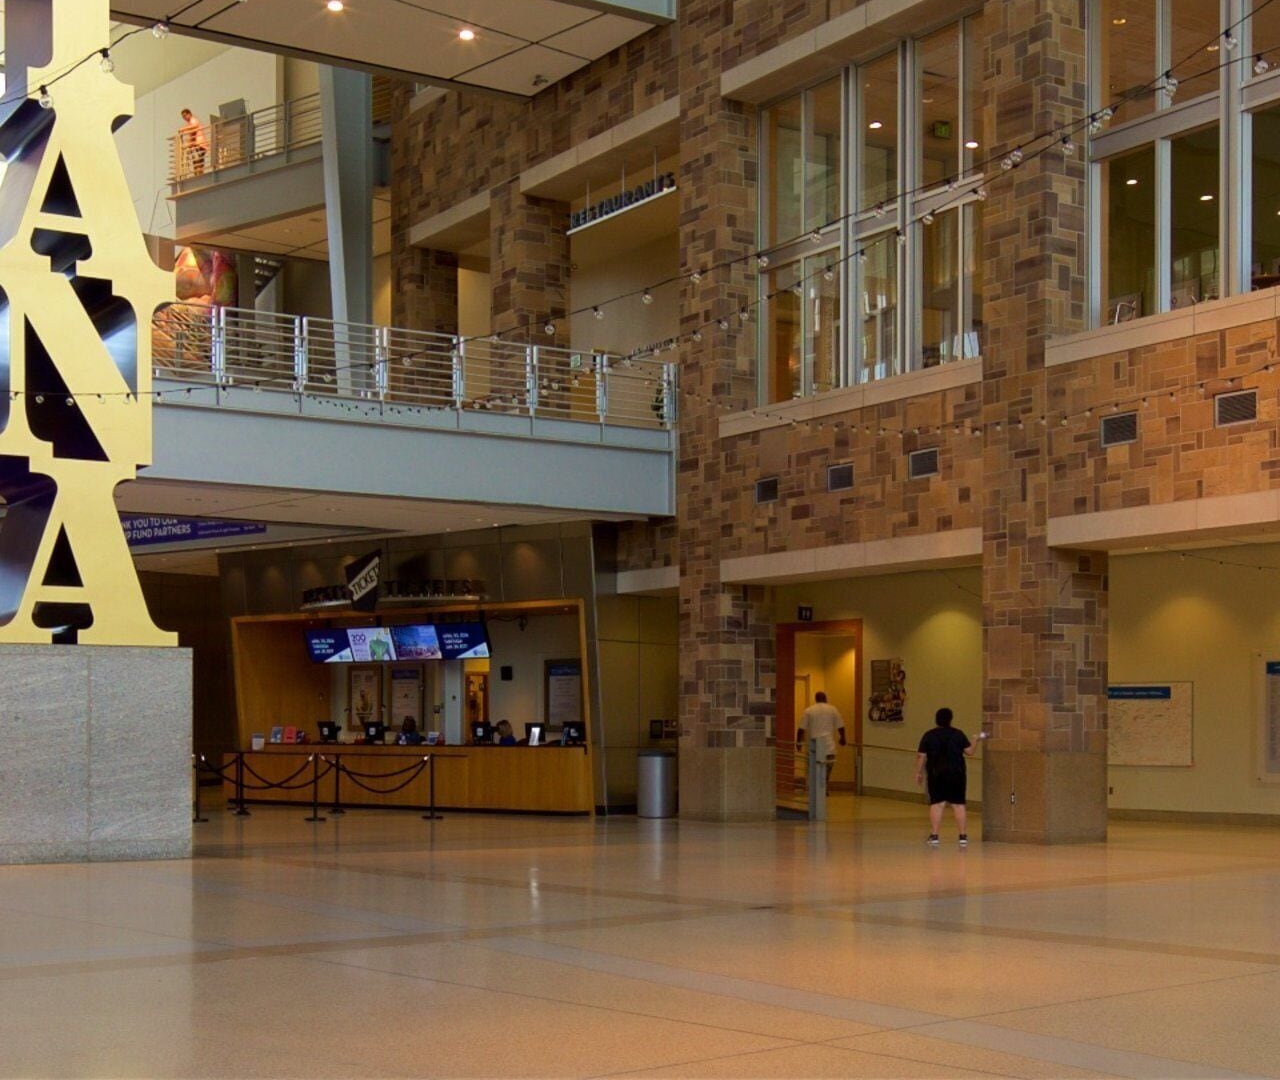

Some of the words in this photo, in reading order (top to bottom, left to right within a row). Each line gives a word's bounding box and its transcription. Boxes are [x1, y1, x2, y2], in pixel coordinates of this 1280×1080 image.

[571, 172, 676, 228] RESTAURANTS
[132, 518, 149, 529] YOU
[132, 528, 153, 539] FUND
[154, 524, 192, 537] PARTNERS
